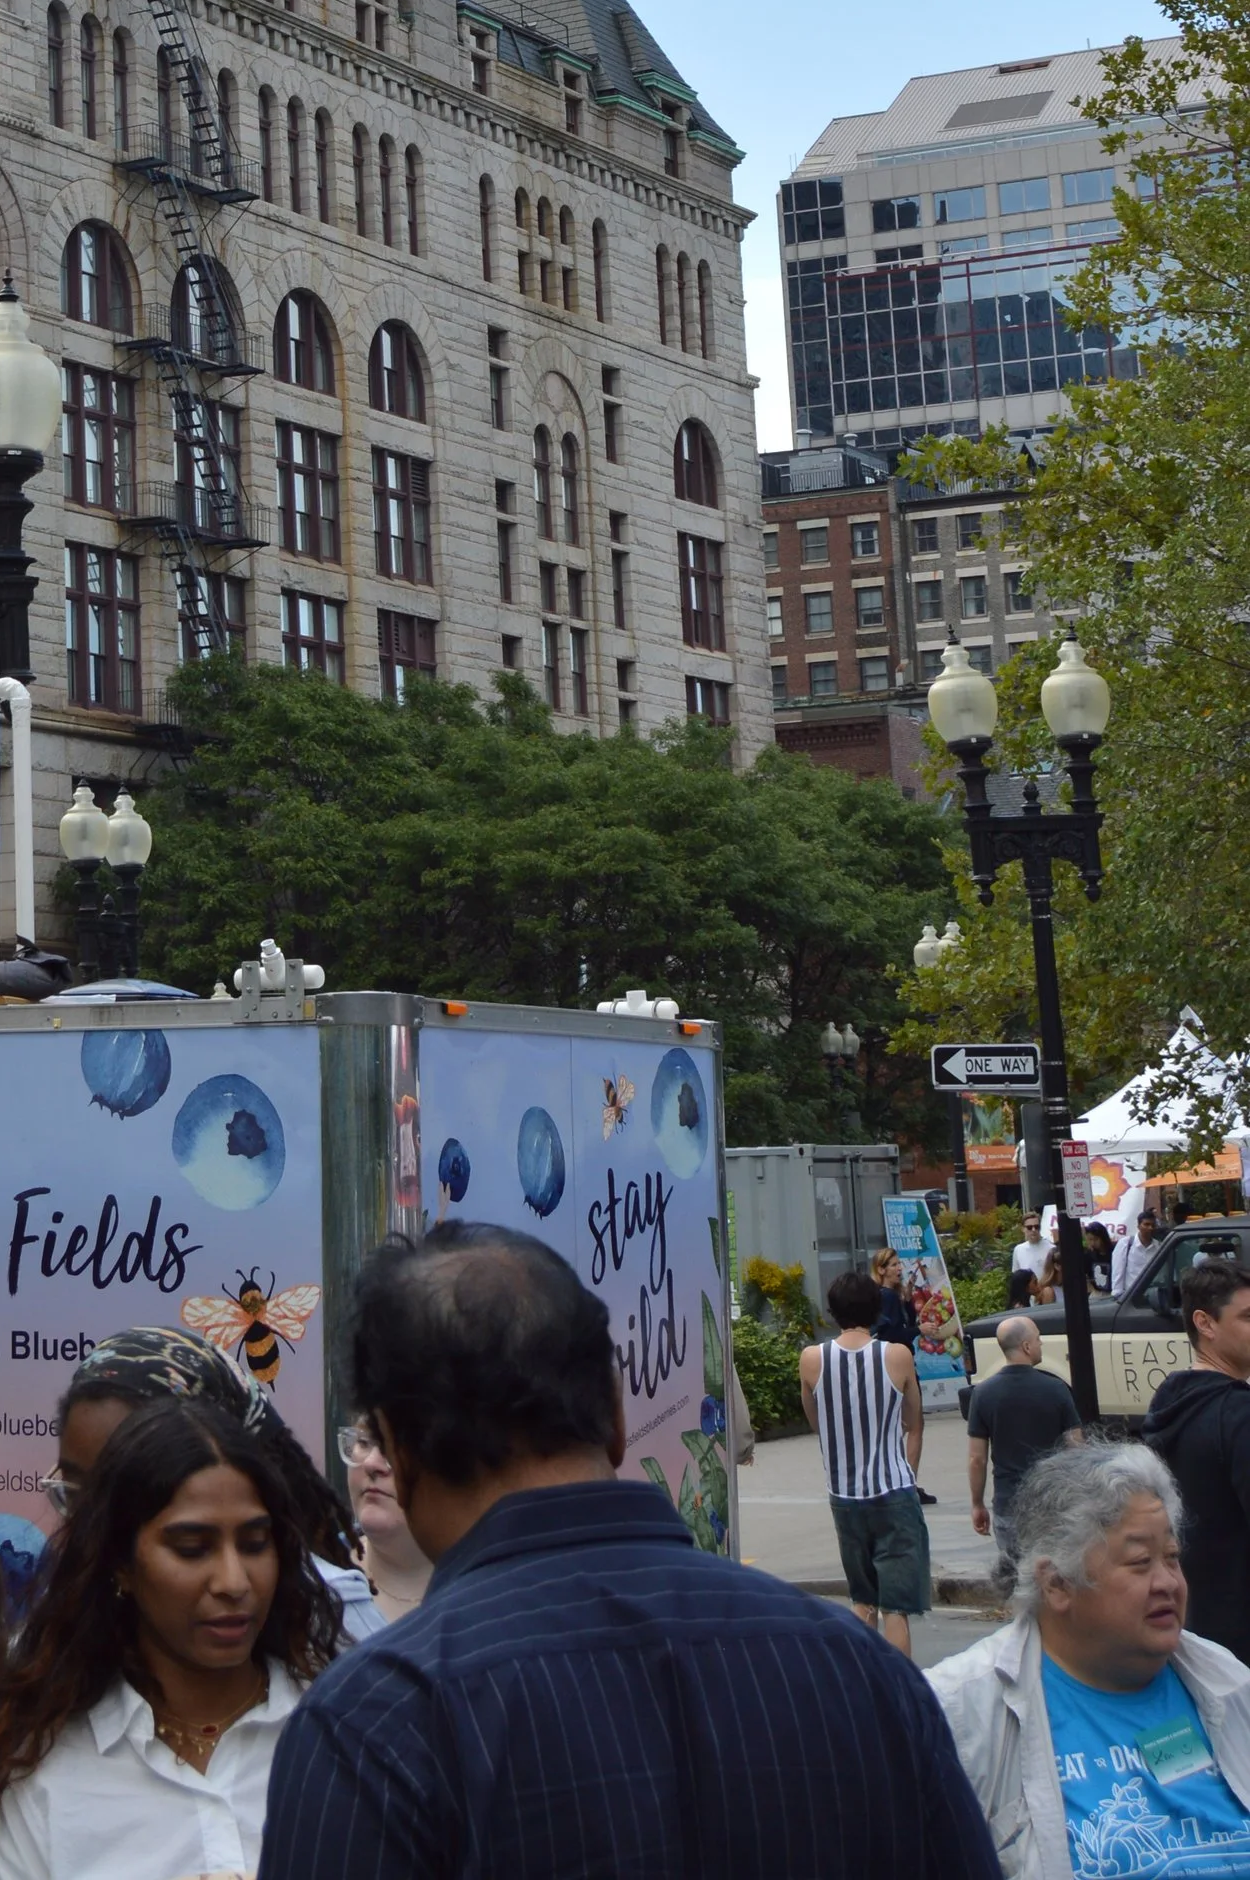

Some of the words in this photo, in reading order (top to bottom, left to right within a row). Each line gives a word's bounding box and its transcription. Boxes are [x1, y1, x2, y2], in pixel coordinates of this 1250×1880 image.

[965, 1058, 992, 1072] ONE
[1000, 1058, 1029, 1072] WAY
[1071, 1161, 1081, 1170] NO
[1066, 1172, 1089, 1180] STOPPING
[1074, 1191, 1085, 1199] TIME
[887, 1213, 903, 1225] NEW
[587, 1168, 674, 1295] stay
[889, 1225, 923, 1237] ENGLAND
[8, 1186, 204, 1297] Fields
[890, 1237, 923, 1250] VILLAGE
[10, 1330, 96, 1362] Blueb
[1125, 1368, 1167, 1392] RO
